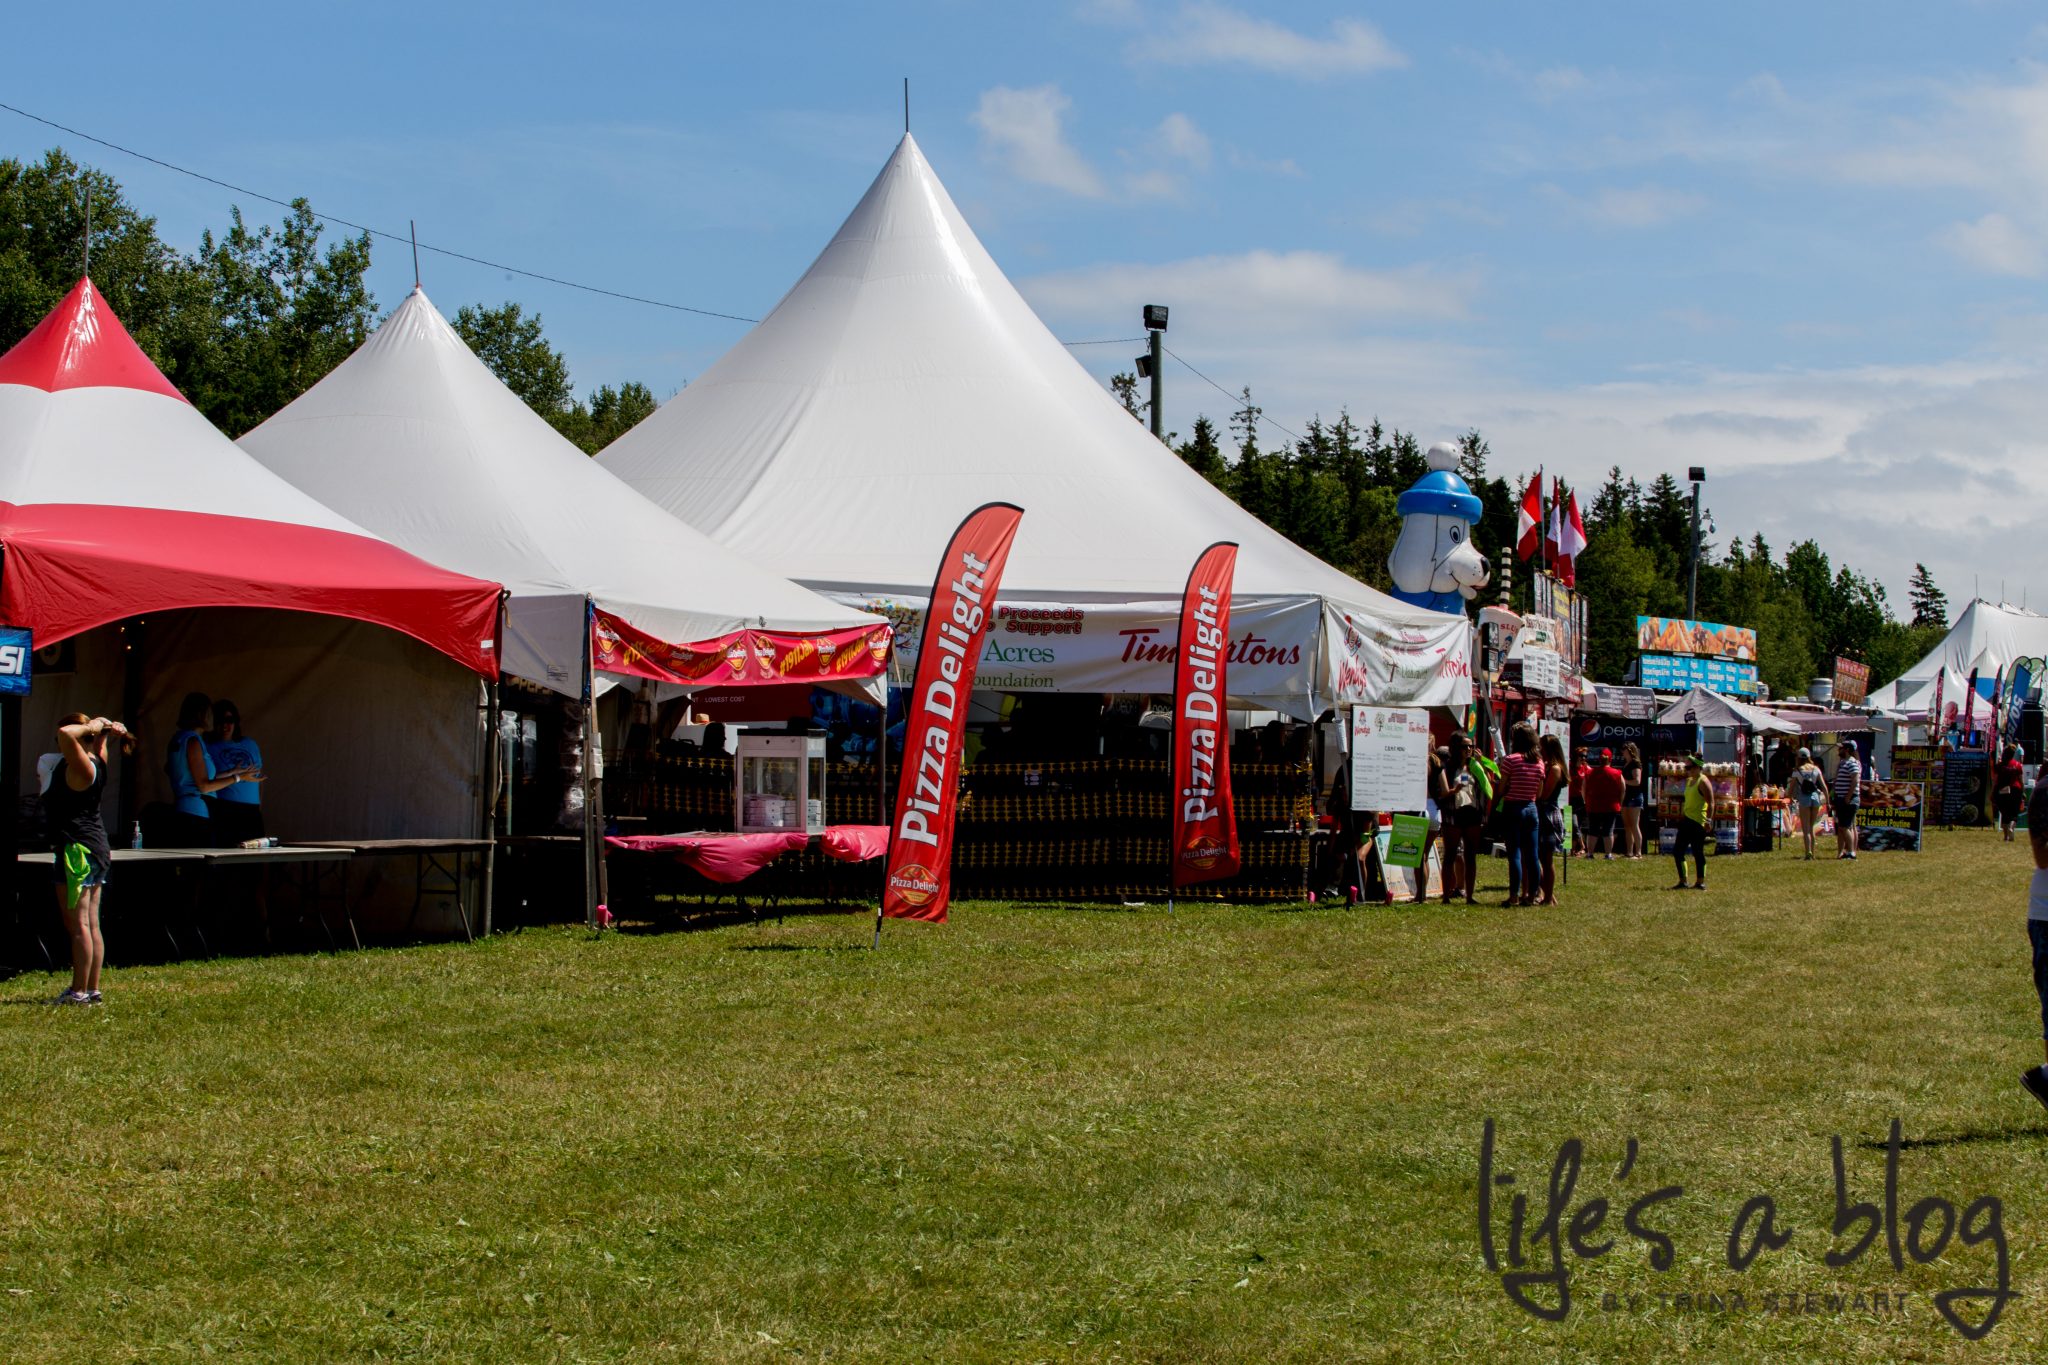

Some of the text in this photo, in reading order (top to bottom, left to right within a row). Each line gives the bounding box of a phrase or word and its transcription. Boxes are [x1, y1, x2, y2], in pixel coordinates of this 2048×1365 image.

[998, 605, 1084, 621] Proceeds
[985, 620, 1083, 636] o Support
[924, 551, 990, 724] Delight
[983, 639, 1055, 663] Acres
[1118, 628, 1300, 665] Tim rtons
[972, 673, 1055, 688] oundation
[705, 696, 729, 704] LOWEST
[729, 695, 746, 703] COST
[1183, 585, 1223, 824] Pizza Delight
[1603, 725, 1645, 739] pepsi
[899, 725, 950, 847] Pizza
[1200, 845, 1229, 857] Delight
[890, 876, 940, 893] Pizza Delight
